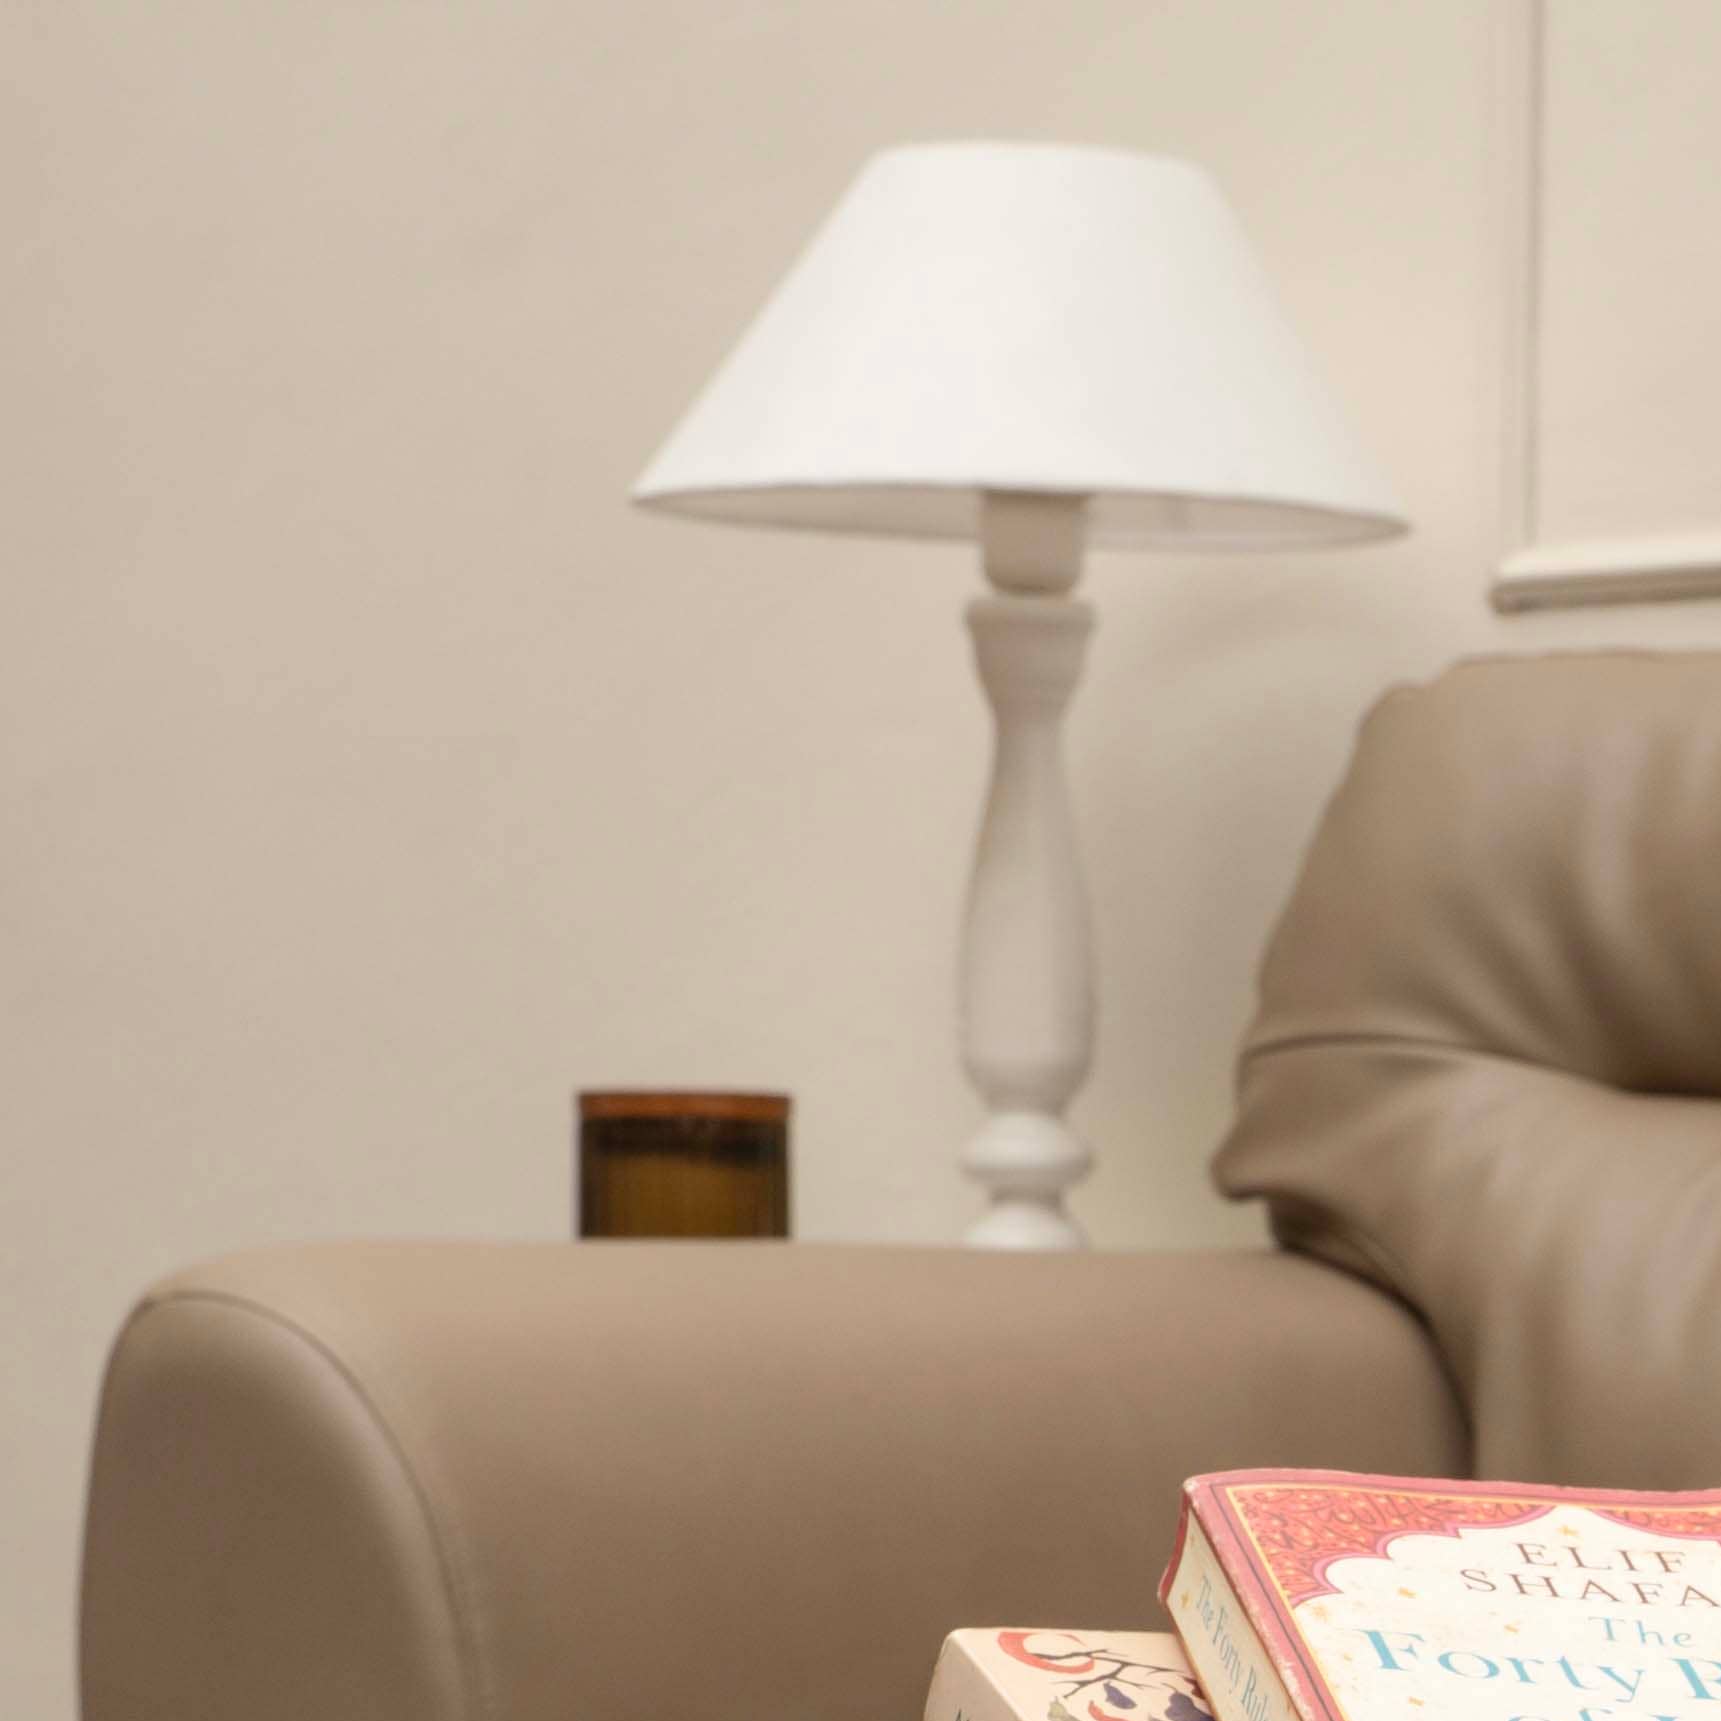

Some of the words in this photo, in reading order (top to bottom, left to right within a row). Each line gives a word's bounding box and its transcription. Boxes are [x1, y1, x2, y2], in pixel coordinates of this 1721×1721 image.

[1516, 1543, 1686, 1573] ELIF
[1212, 1606, 1242, 1688] Forty
[1587, 1616, 1697, 1647] The
[1352, 1629, 1645, 1703] Forty
